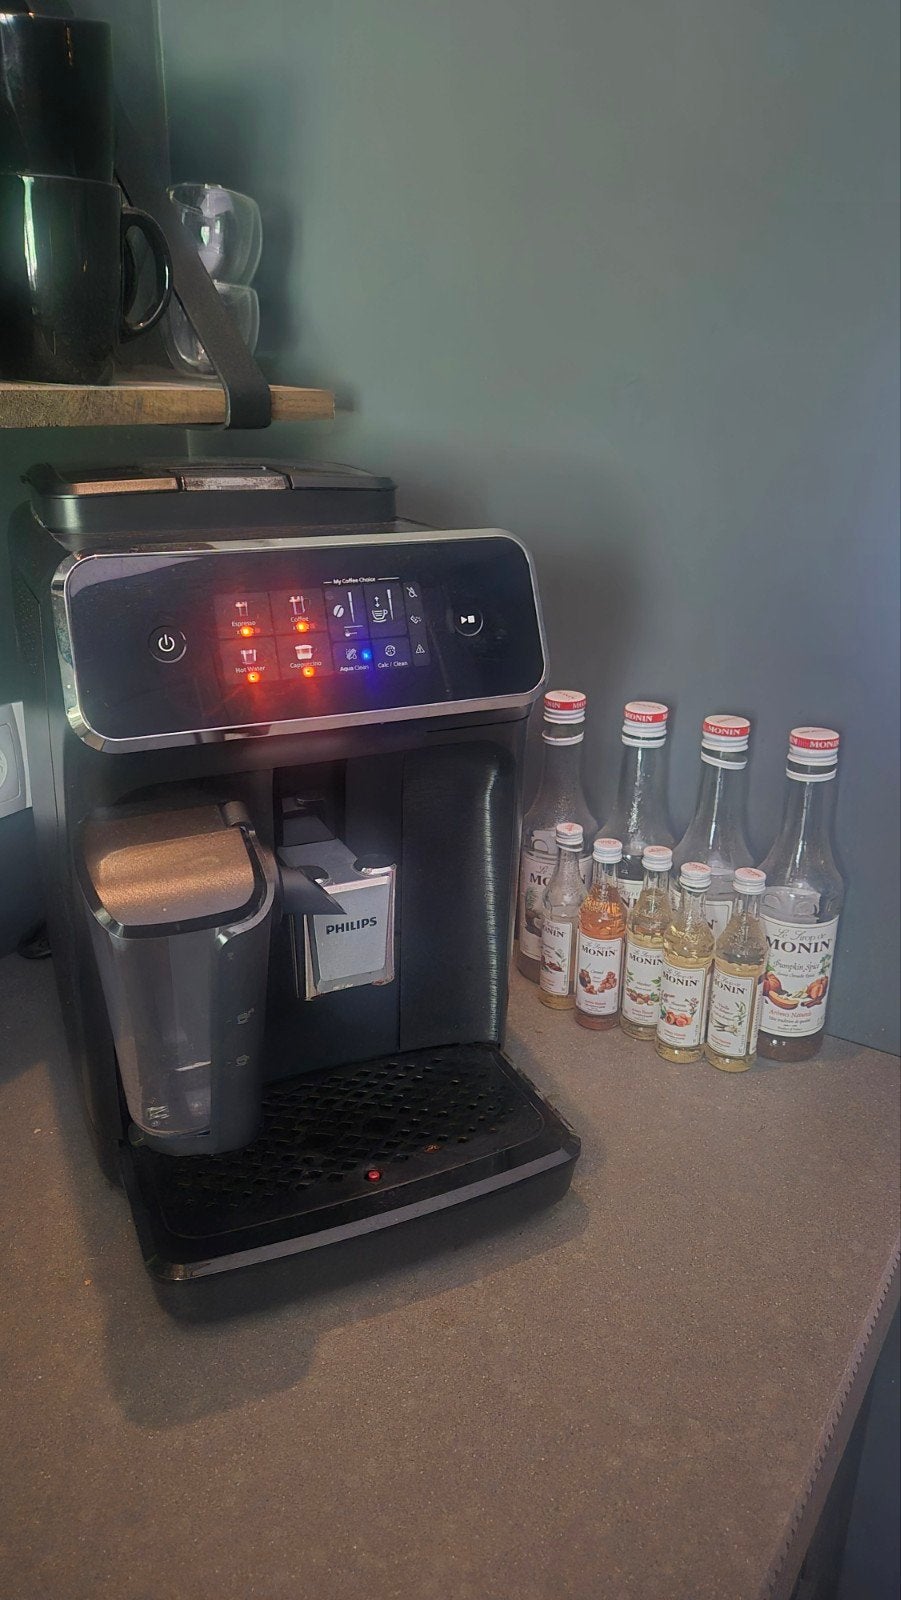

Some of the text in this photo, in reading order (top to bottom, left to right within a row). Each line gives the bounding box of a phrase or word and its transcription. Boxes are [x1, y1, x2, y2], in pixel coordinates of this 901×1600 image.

[231, 620, 256, 628] Espresso
[247, 664, 265, 672] Water
[340, 665, 354, 673] Aqua
[708, 725, 741, 735] MONIN
[326, 917, 378, 935] PHILIPS
[766, 936, 830, 953] MONIN
[582, 945, 616, 957] MONIN
[629, 953, 663, 966] MONIN
[662, 971, 698, 987] MONIN
